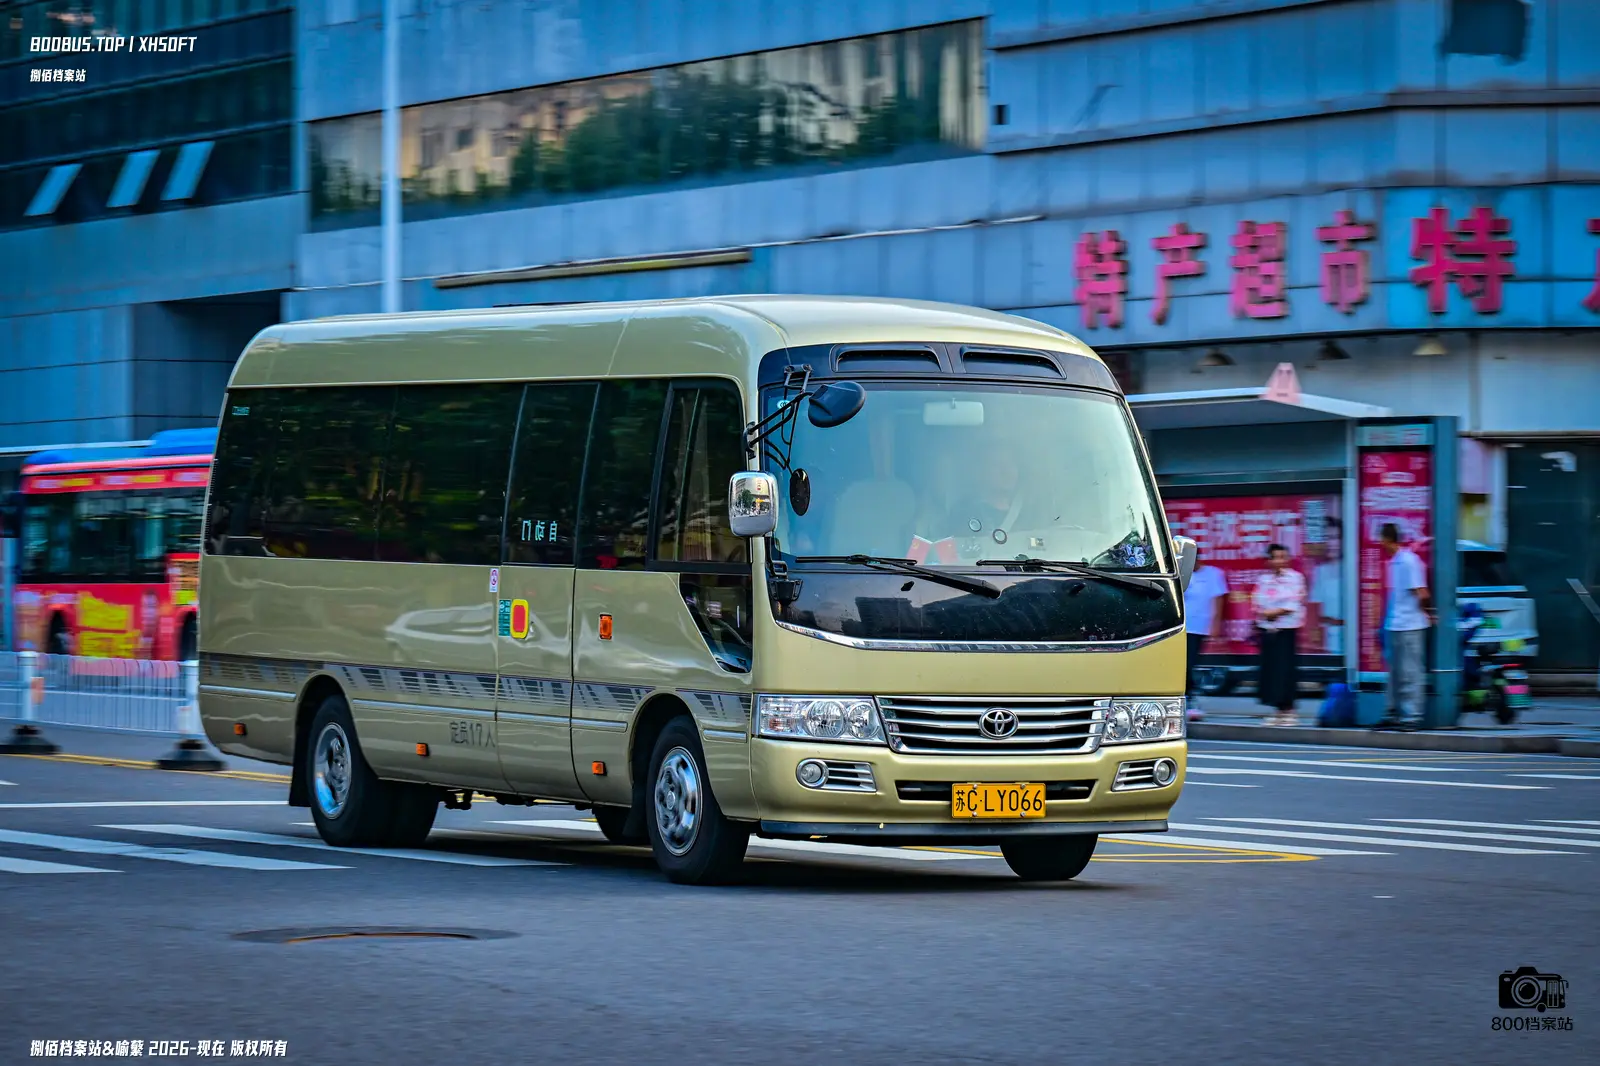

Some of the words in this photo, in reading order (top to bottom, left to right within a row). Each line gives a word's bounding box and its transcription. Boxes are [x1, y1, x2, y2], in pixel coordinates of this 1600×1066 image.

[1074, 208, 1377, 329] 特产超市
[1410, 206, 1600, 314] 特
[449, 721, 496, 747] 定员17人
